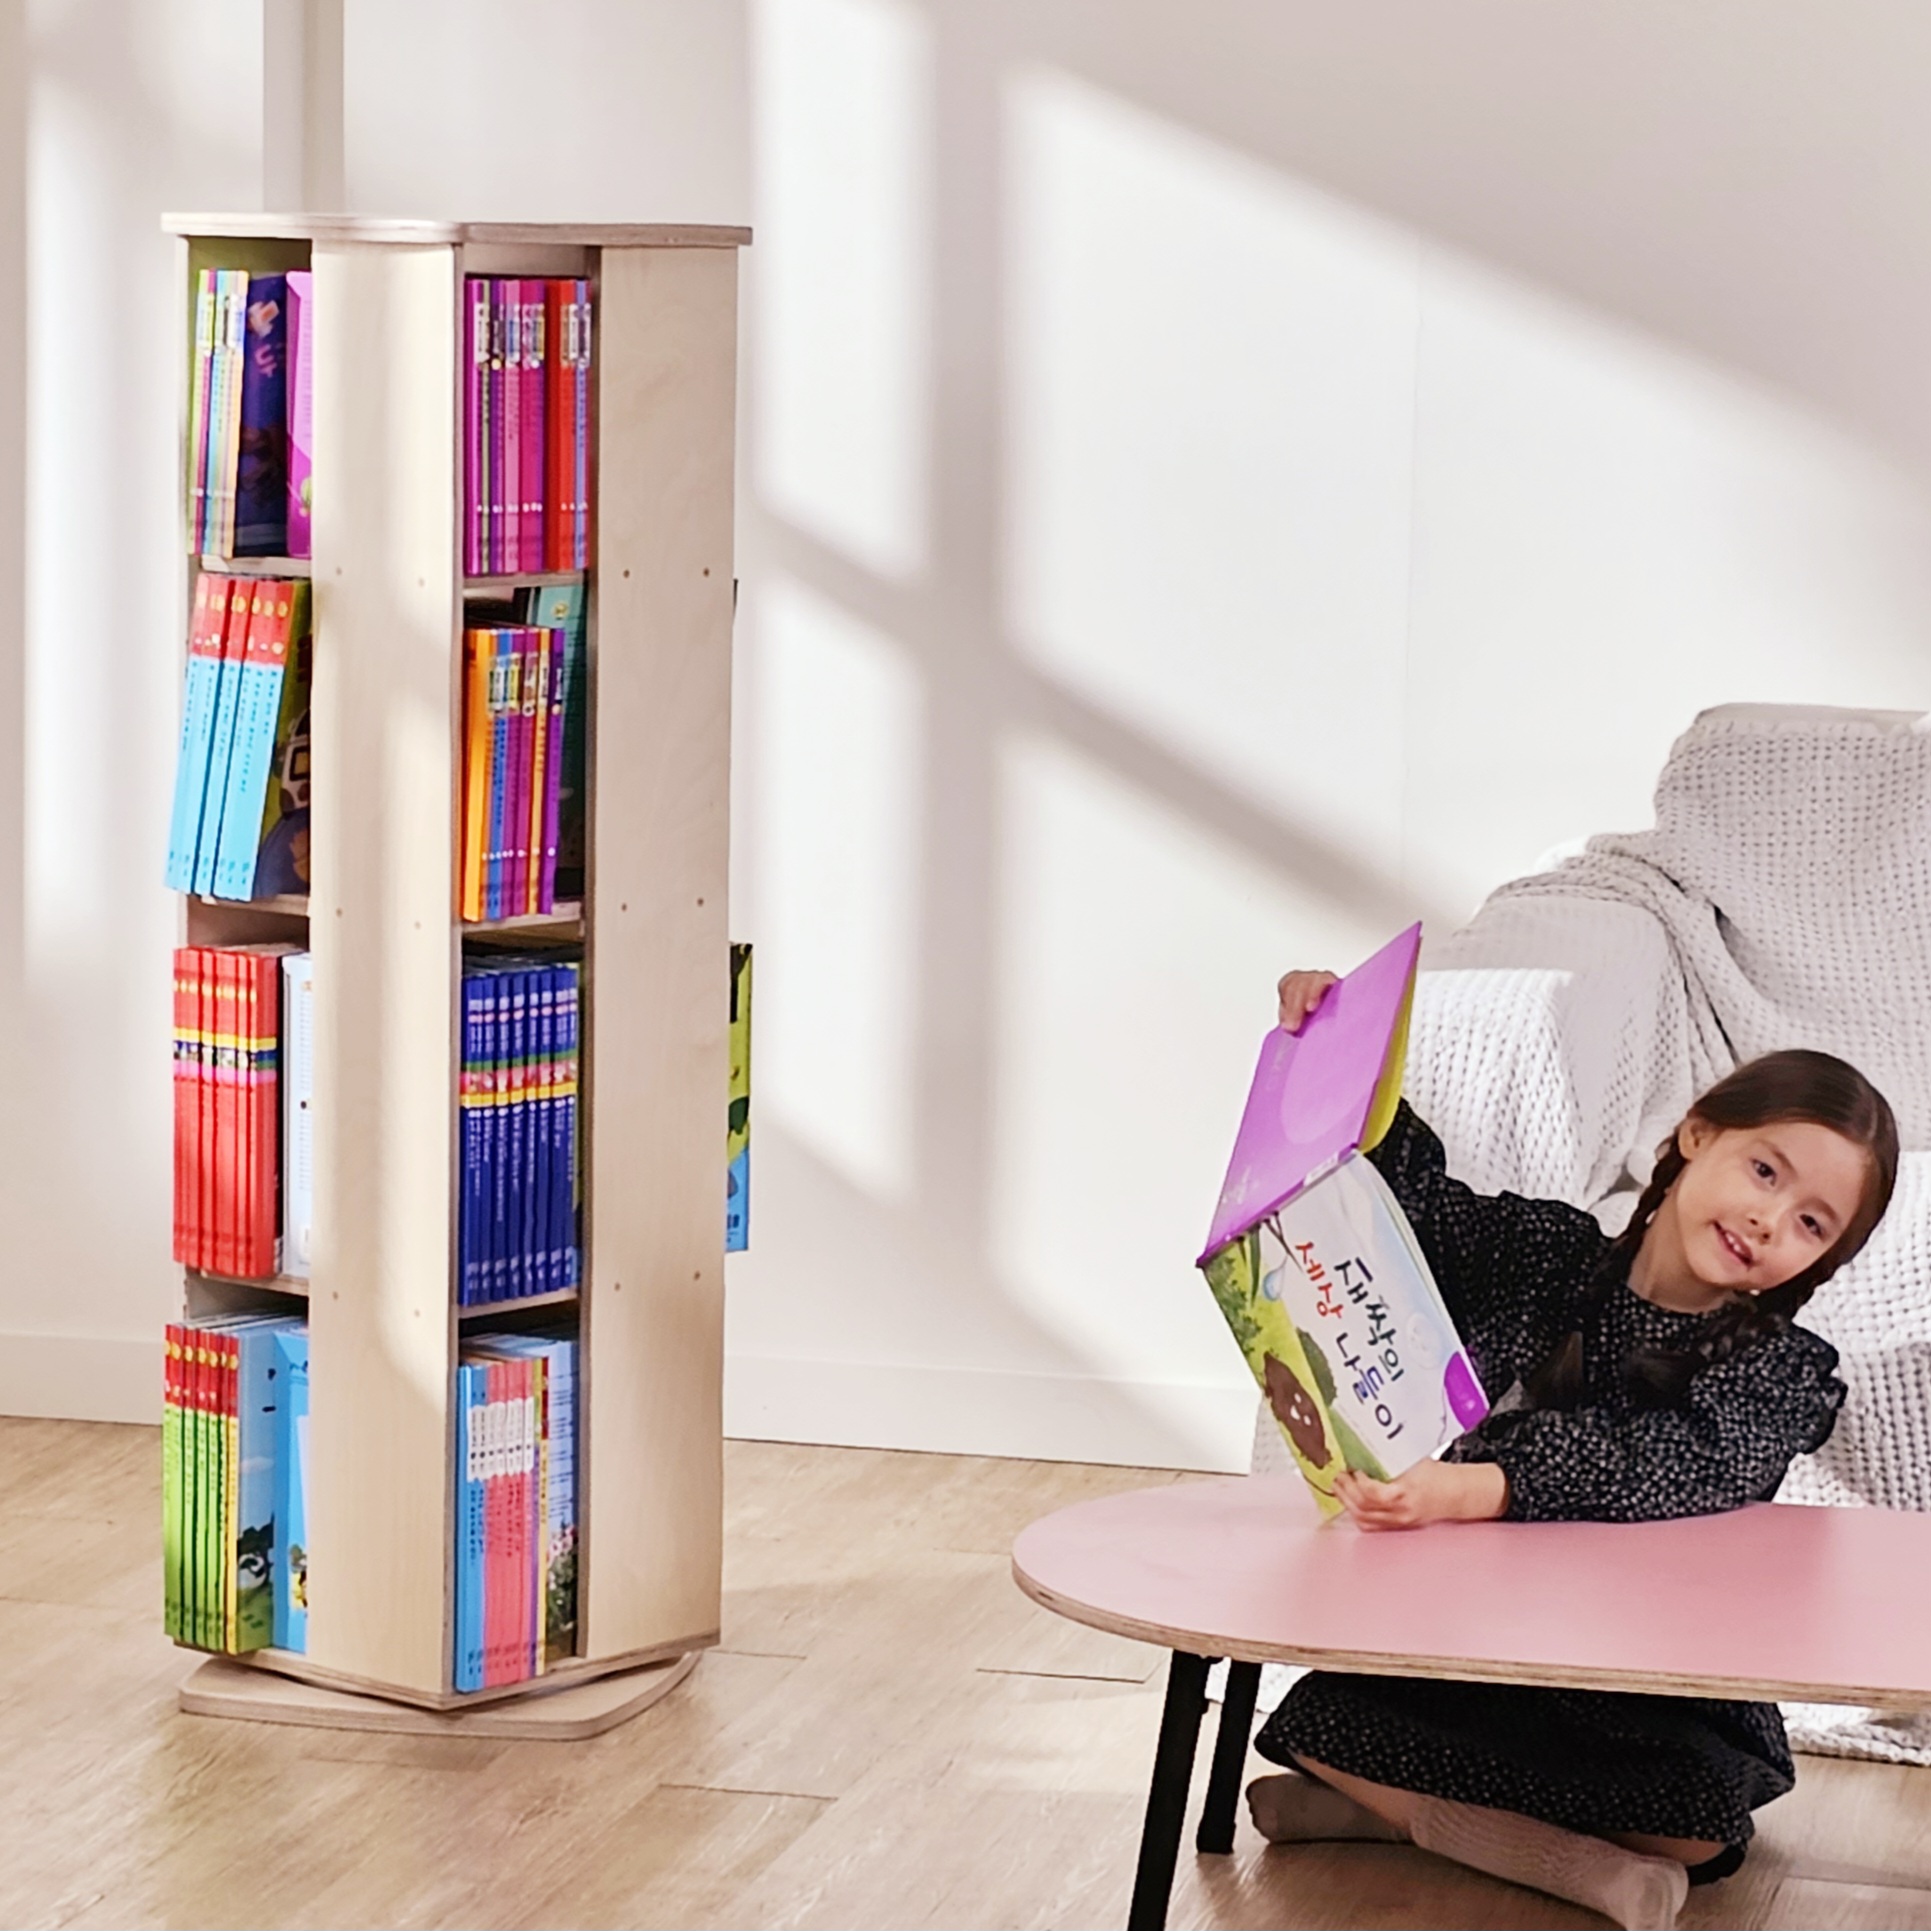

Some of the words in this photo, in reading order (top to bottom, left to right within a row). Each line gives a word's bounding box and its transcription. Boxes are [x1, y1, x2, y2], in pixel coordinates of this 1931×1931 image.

[1295, 1242, 1344, 1319] 세상
[1336, 1332, 1404, 1440] 나들이
[1334, 1256, 1405, 1382] 새싹의
